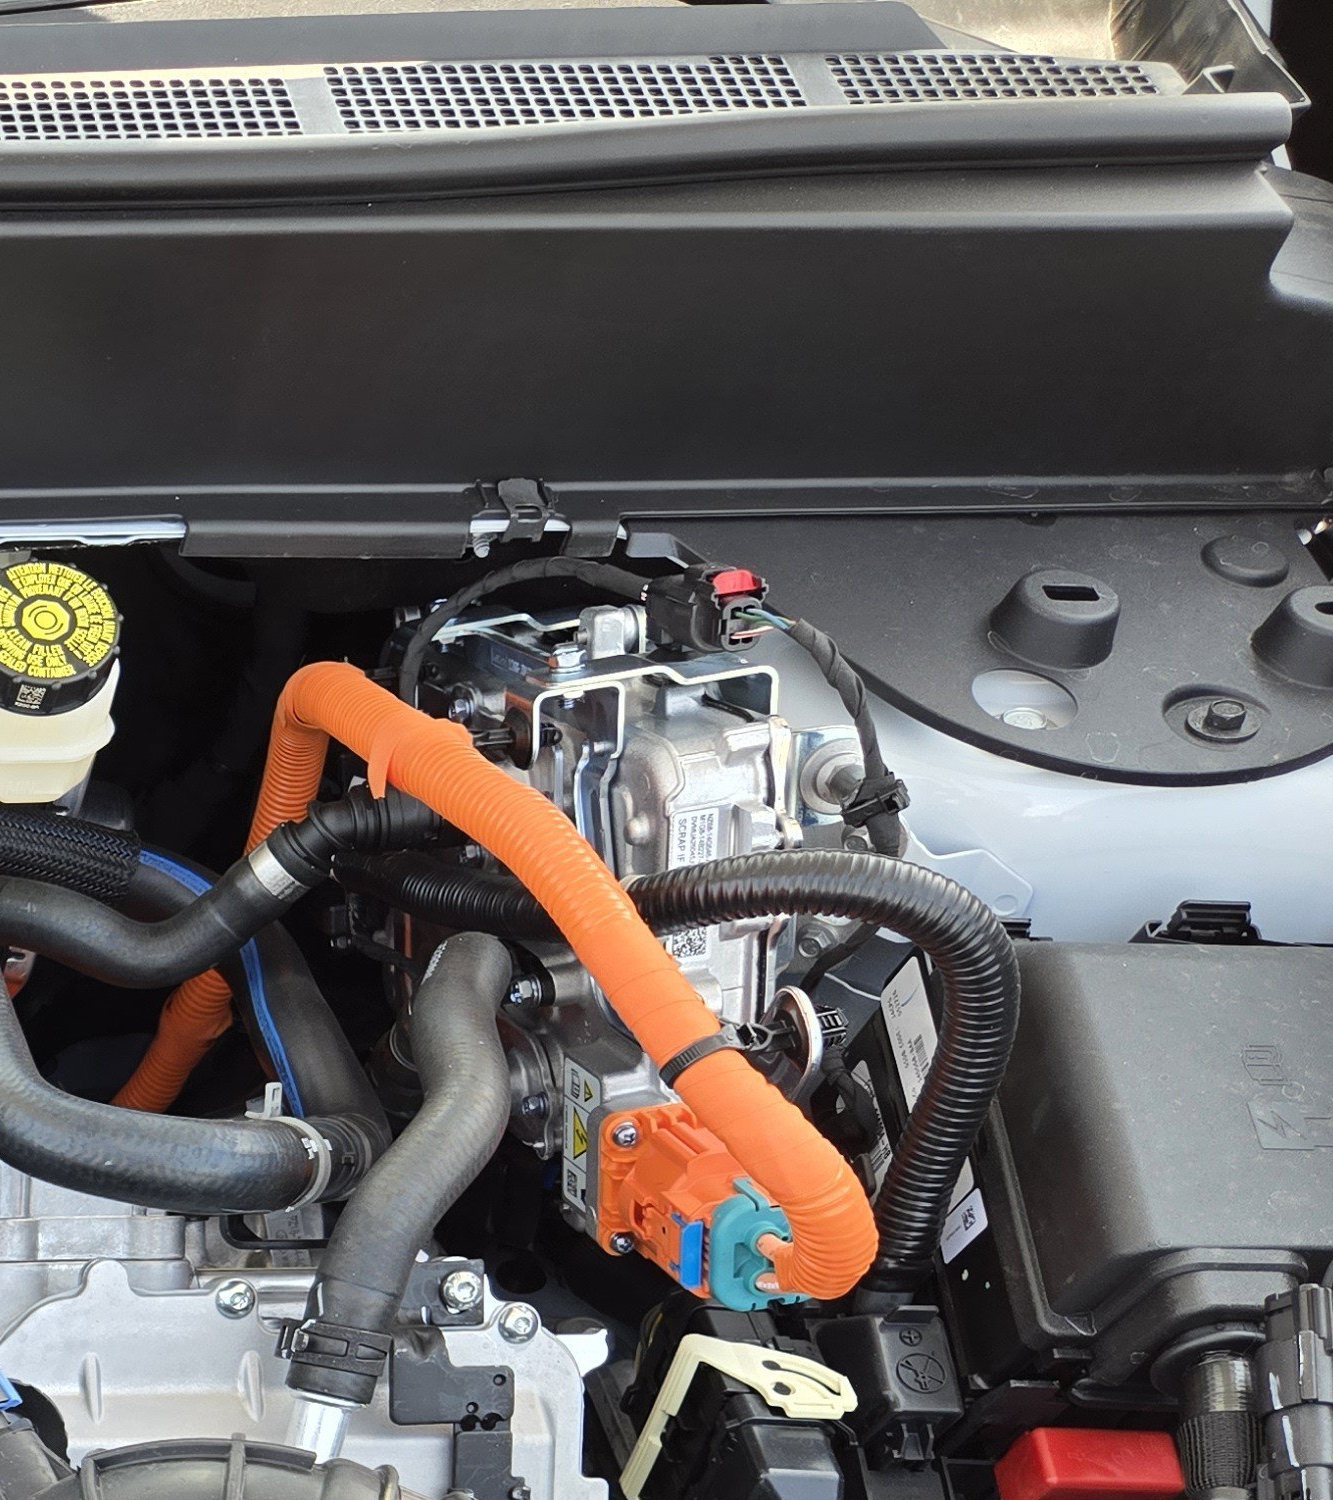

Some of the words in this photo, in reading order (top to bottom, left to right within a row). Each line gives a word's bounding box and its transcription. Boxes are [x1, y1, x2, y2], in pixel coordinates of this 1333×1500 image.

[6, 628, 32, 651] CLEAN
[32, 643, 64, 656] FILLER
[24, 653, 43, 666] USE
[45, 654, 69, 666] ONLY
[27, 664, 76, 677] CONTAINER
[678, 818, 688, 851] SCRAP
[677, 853, 687, 863] IF
